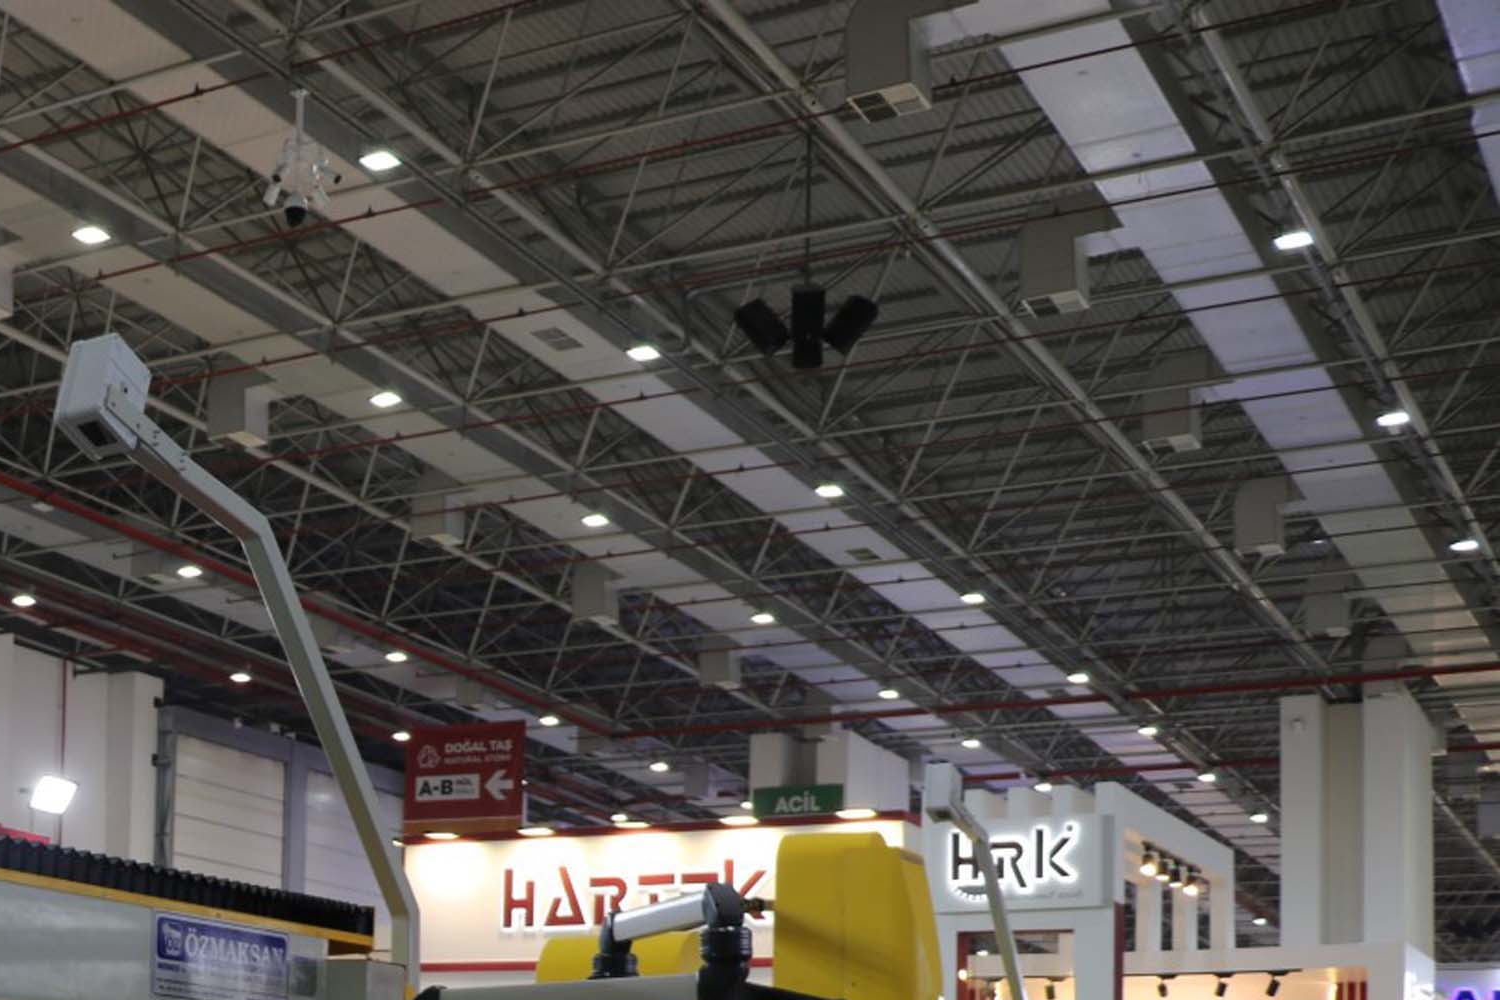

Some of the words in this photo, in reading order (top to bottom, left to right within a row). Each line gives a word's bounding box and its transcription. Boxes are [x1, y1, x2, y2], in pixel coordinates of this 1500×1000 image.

[418, 779, 453, 796] A-B
[952, 829, 1070, 888] HRK
[184, 928, 285, 966] ÖZMAKSAN
